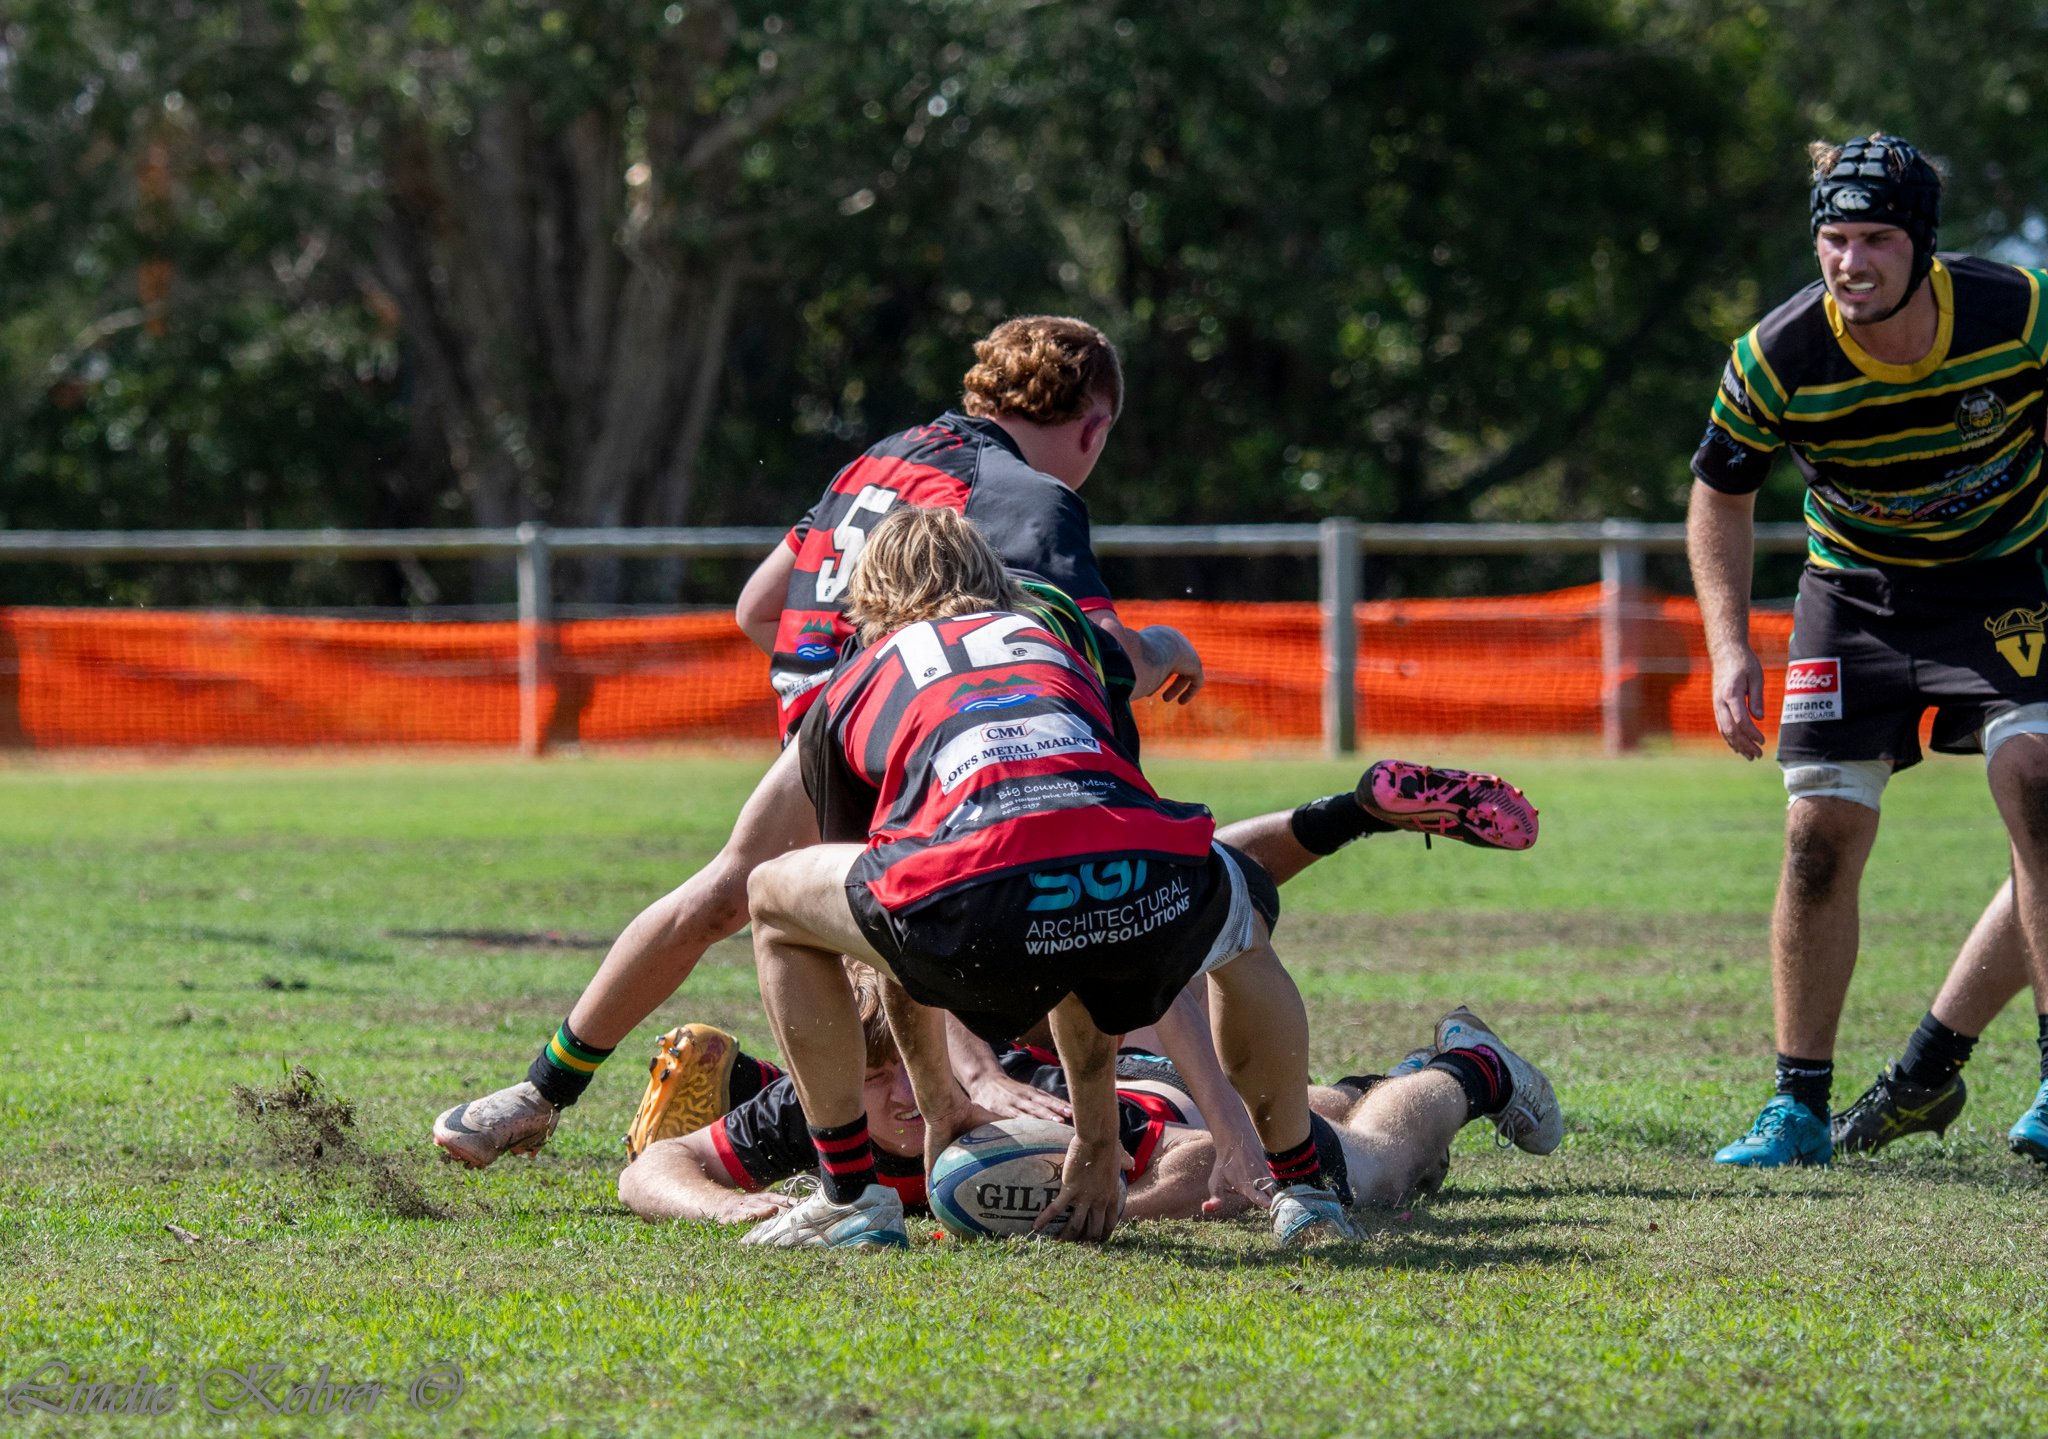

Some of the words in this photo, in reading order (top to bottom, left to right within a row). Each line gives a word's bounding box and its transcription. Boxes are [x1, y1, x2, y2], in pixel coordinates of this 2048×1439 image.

[815, 485, 899, 603] 5
[874, 612, 1071, 690] 12
[1785, 668, 1834, 690] Elders
[986, 725, 1025, 740] CMM
[982, 743, 1034, 760] METAL
[1036, 736, 1098, 751] MARKET
[1019, 752, 1038, 761] LTD
[996, 786, 1021, 801] Big
[1023, 781, 1079, 793] Country
[1026, 876, 1190, 939] ARCHITECTURAL
